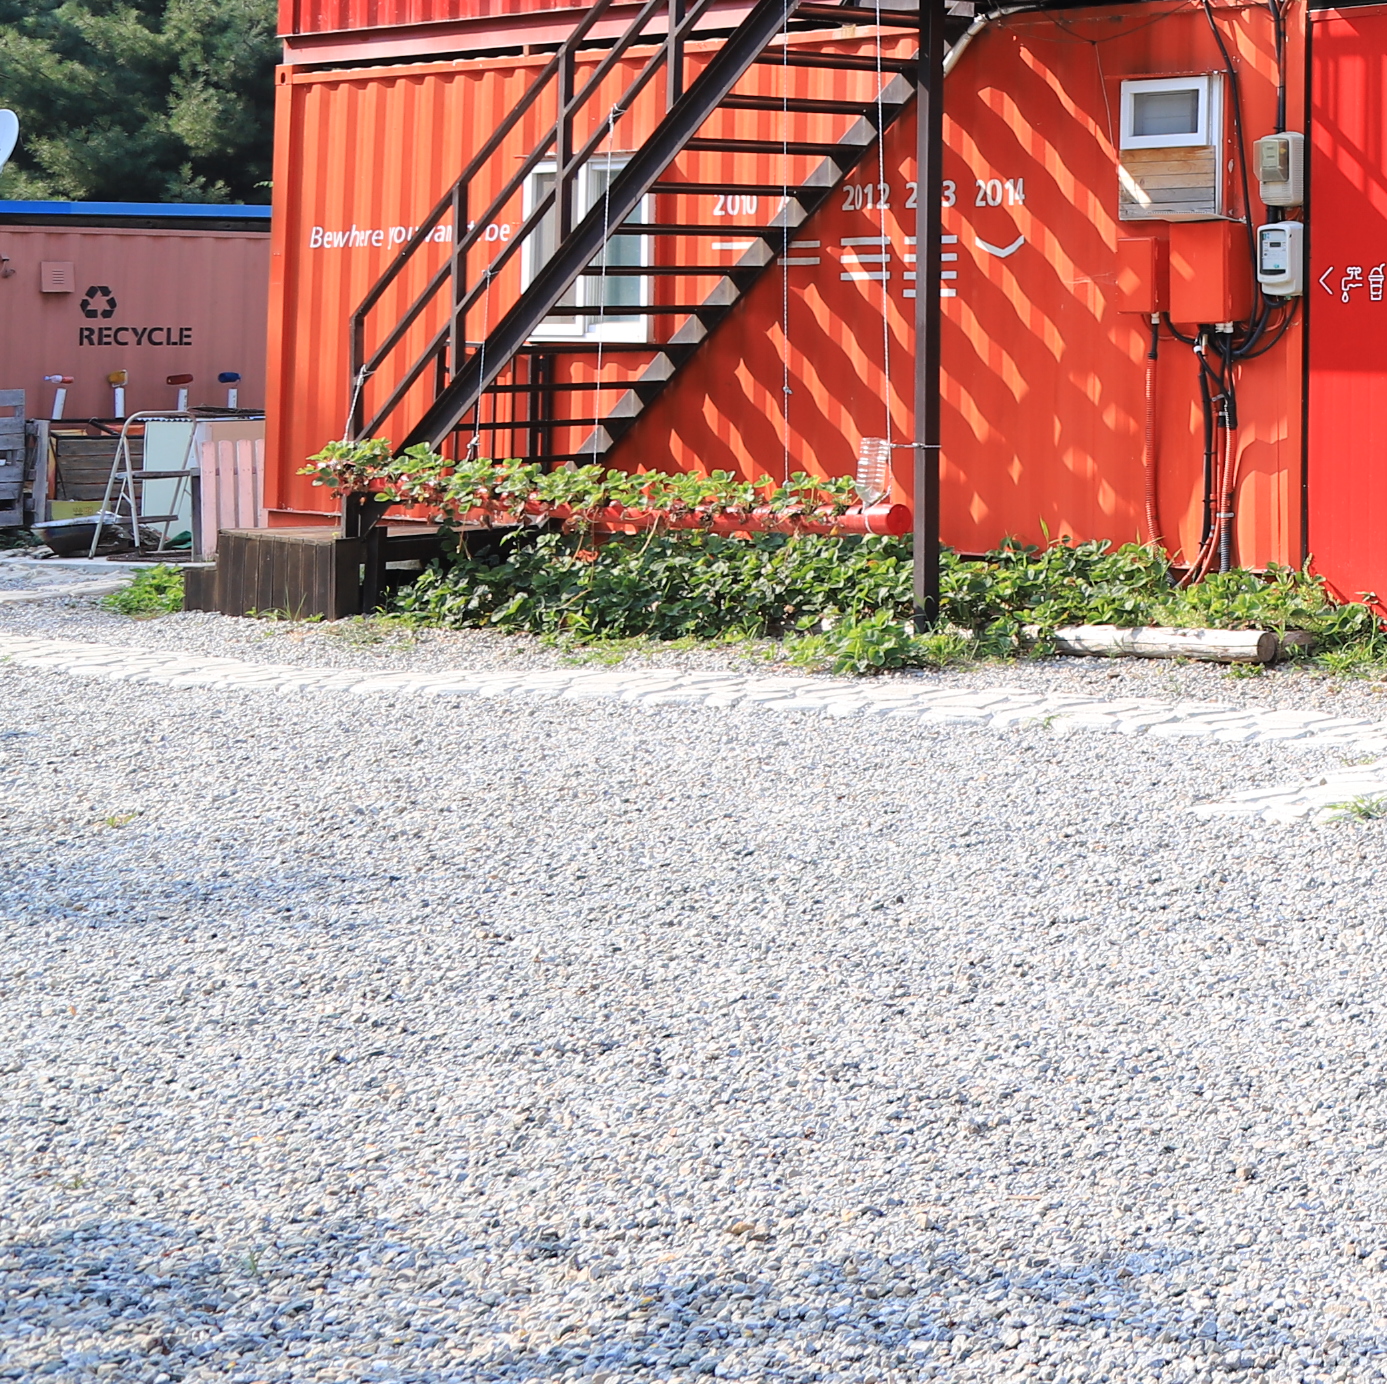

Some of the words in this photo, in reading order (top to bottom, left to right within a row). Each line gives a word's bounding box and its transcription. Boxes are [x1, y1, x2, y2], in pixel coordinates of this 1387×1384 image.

[713, 193, 757, 216] 2010
[842, 182, 890, 211] 2012
[905, 180, 957, 209] 23
[975, 178, 1026, 207] 2014
[78, 326, 193, 347] RECYCLE
